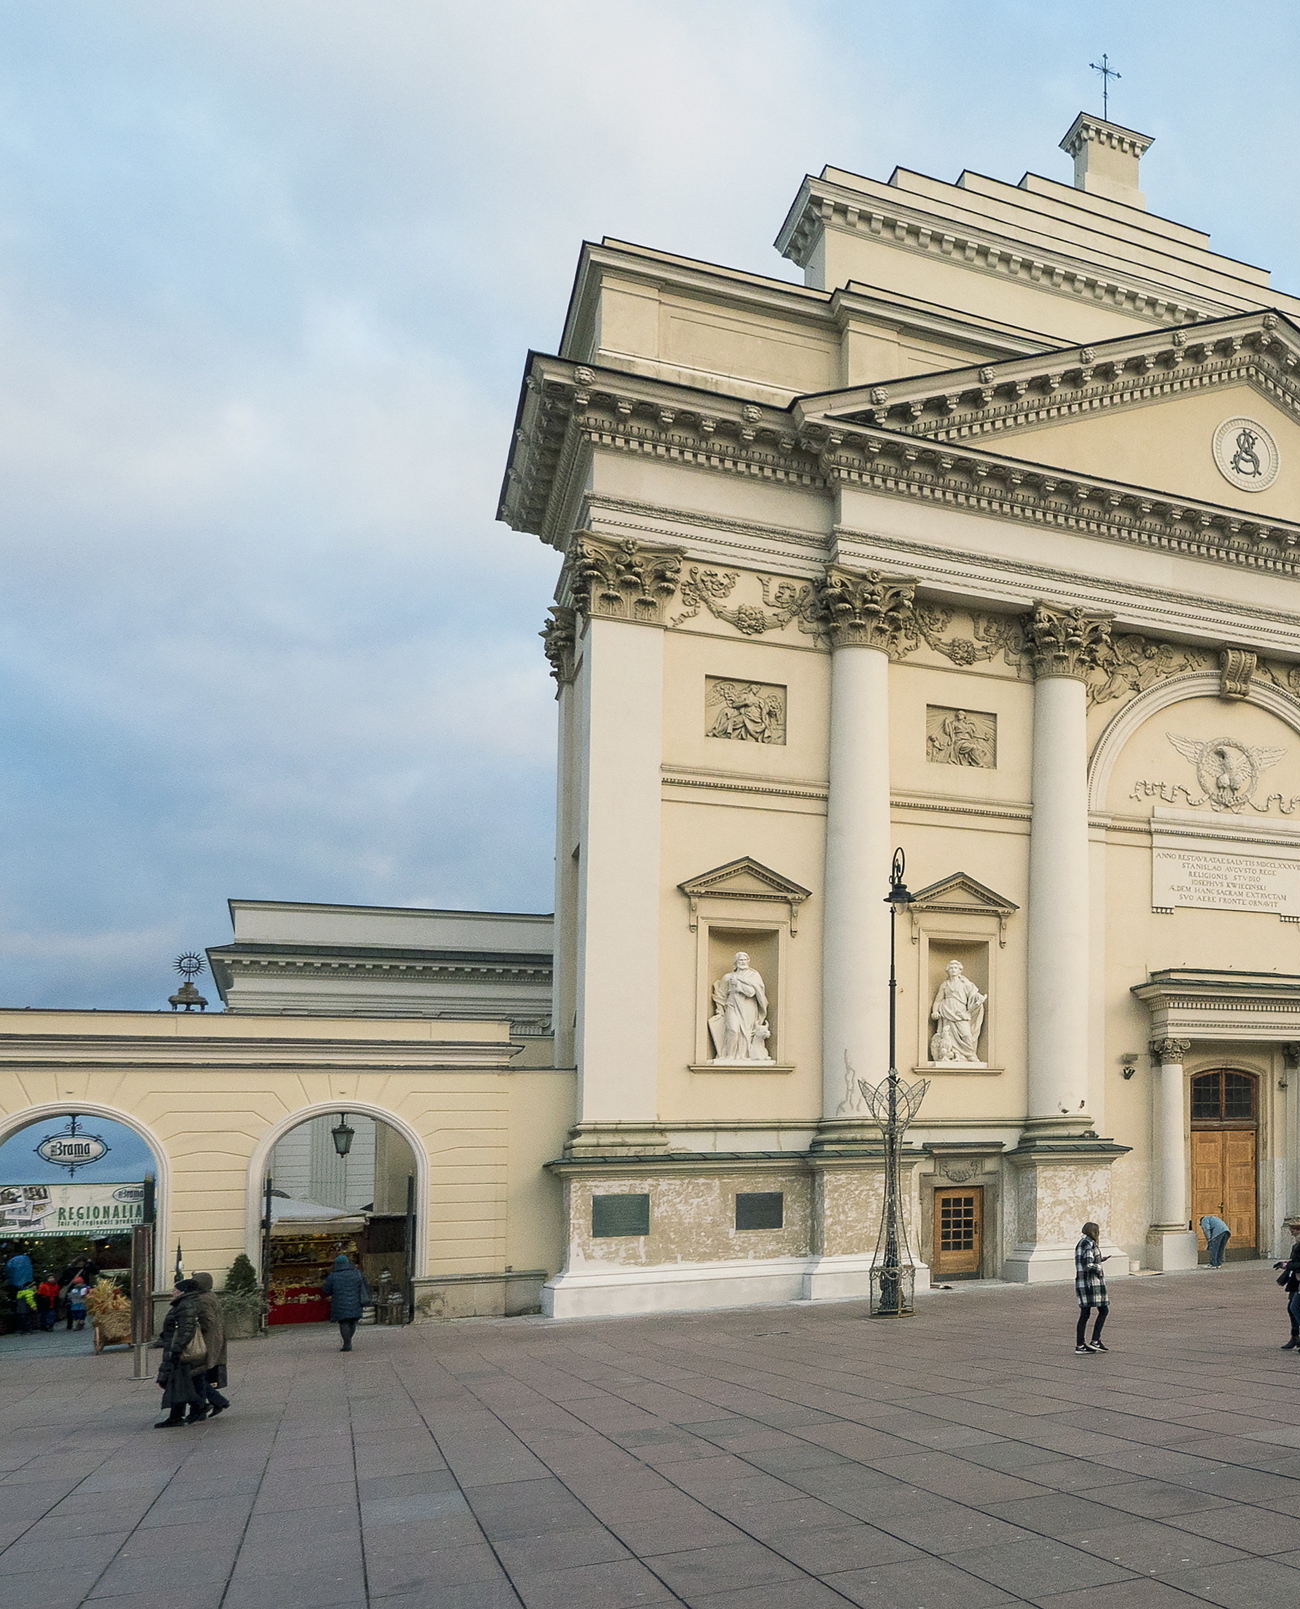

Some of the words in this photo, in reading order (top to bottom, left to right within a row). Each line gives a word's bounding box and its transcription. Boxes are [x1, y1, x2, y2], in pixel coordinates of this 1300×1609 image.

[1156, 852, 1177, 860] ANNO
[1226, 858, 1255, 866] SALVTIS
[1182, 862, 1222, 871] STANISLAO
[1225, 866, 1257, 874] AVGVSTO
[1188, 871, 1228, 880] RELIGIONIS
[1191, 879, 1224, 887] IOSEPHVS
[1216, 889, 1244, 897] SACRAM
[1246, 891, 1287, 901] EXTRVCTAM
[56, 1141, 90, 1156] Brama
[58, 1204, 142, 1220] REGIONALIA
